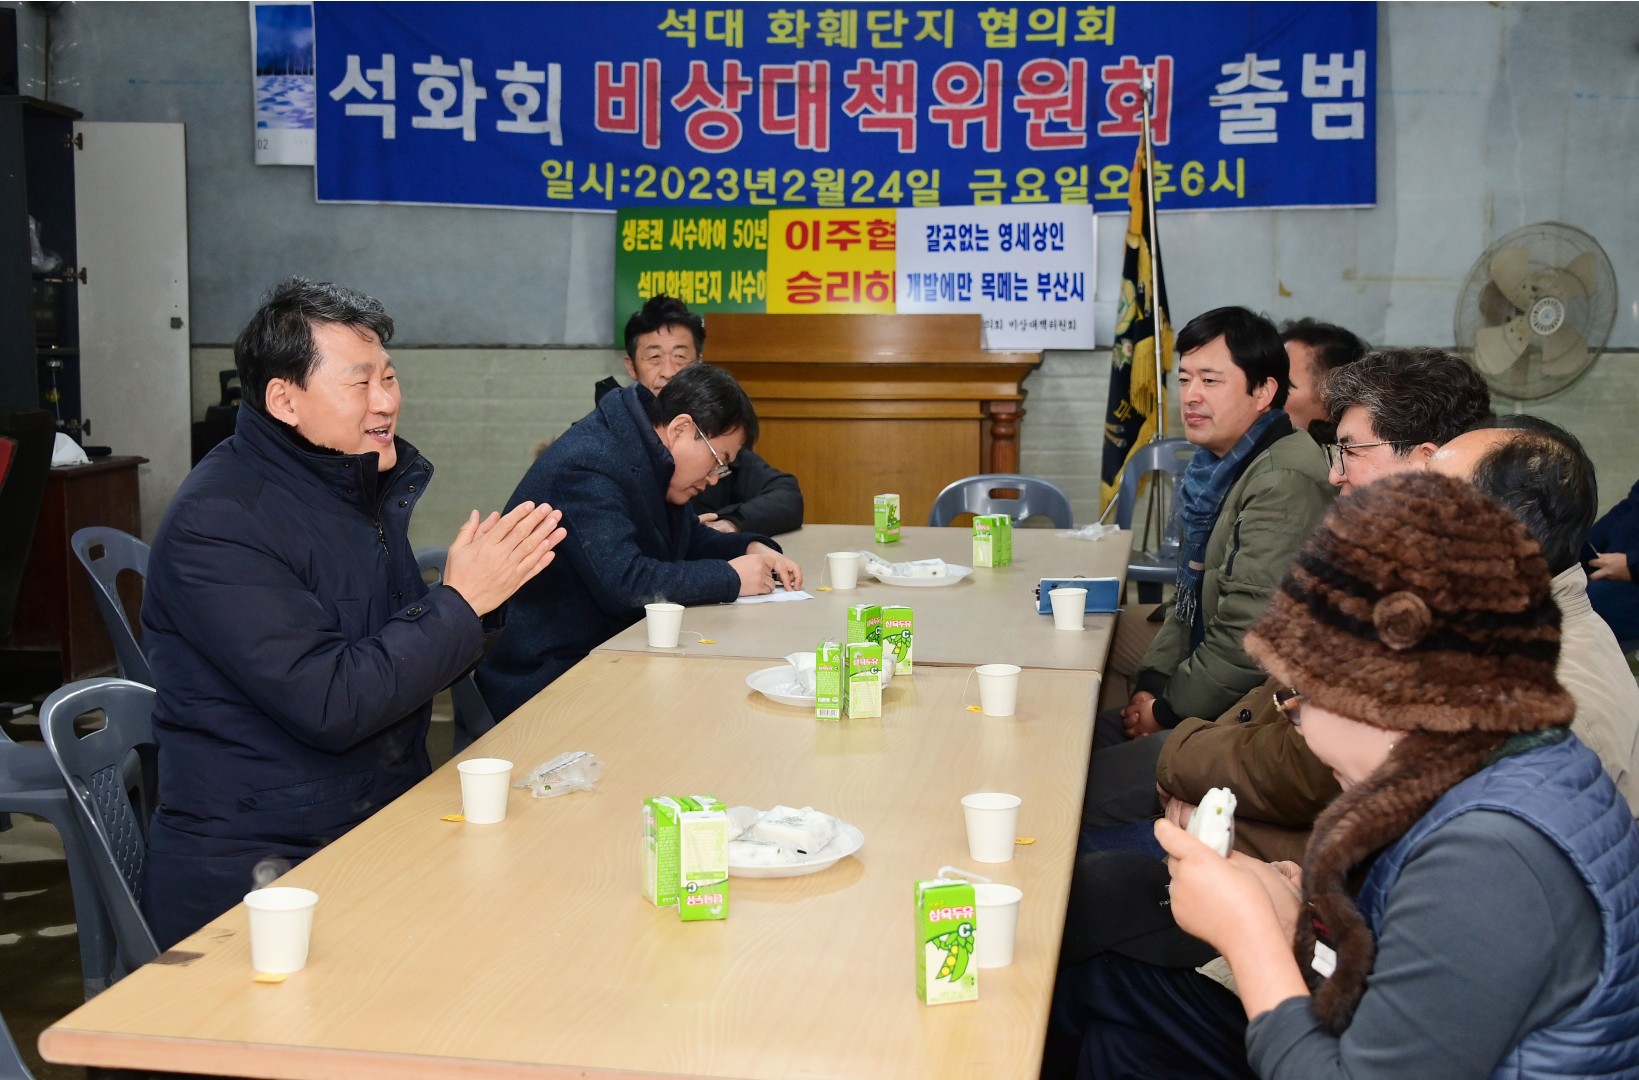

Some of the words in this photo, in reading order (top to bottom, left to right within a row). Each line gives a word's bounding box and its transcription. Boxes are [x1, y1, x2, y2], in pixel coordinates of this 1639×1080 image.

[657, 8, 744, 48] 석대
[766, 8, 954, 49] 화훼단지
[979, 5, 1115, 49] 협의회
[329, 54, 563, 146] 석화회
[594, 55, 1174, 153] 비상대책위원회
[1209, 49, 1366, 145] 출범
[257, 138, 269, 150] 02
[622, 219, 664, 251] 생존권
[669, 218, 727, 250] 사수하여
[733, 218, 768, 250] 50년
[785, 218, 896, 251] 이주협
[926, 224, 989, 253] 갈곳없는
[999, 222, 1064, 252] 영세상인
[907, 273, 972, 302] 개발에만
[981, 272, 1028, 302] 목메는
[1037, 272, 1084, 302] 부산시
[958, 923, 972, 938] C
